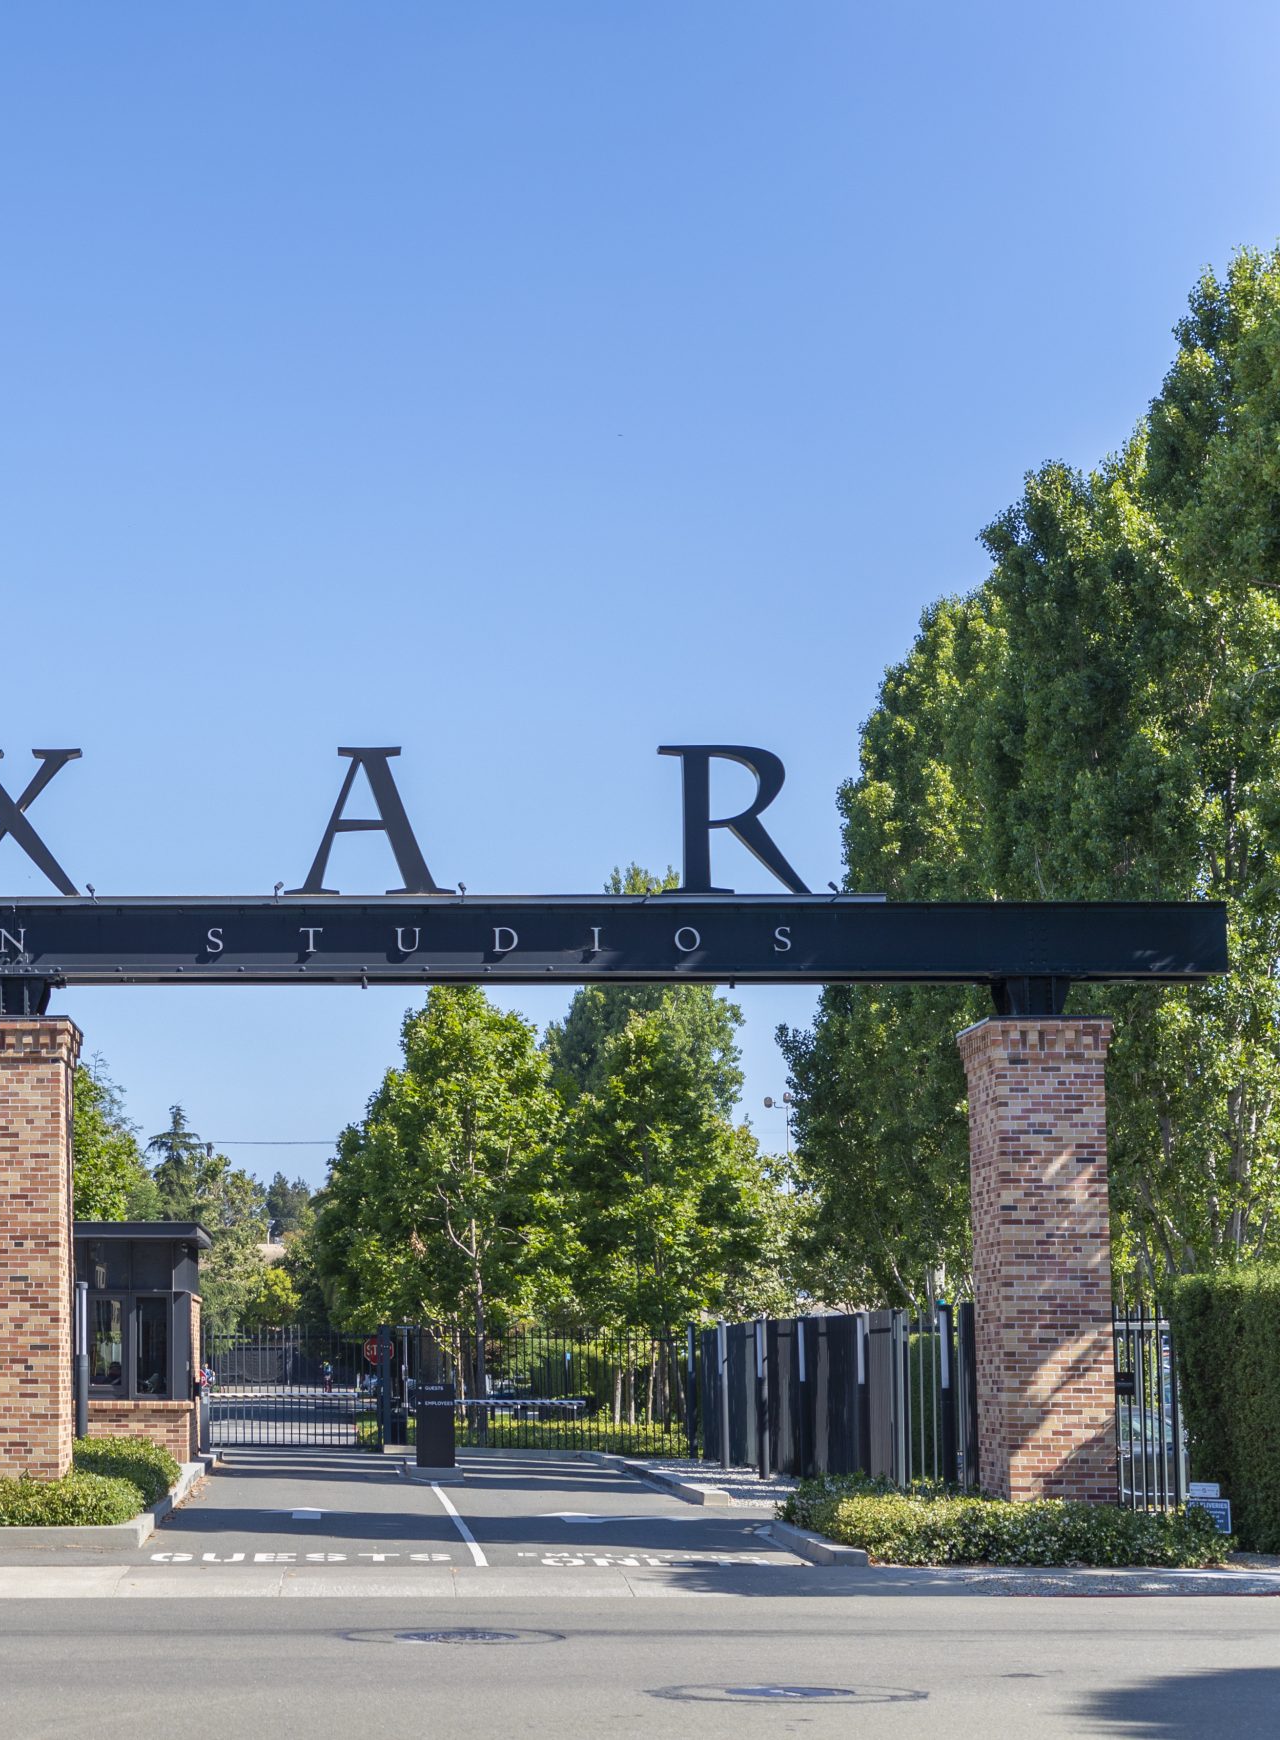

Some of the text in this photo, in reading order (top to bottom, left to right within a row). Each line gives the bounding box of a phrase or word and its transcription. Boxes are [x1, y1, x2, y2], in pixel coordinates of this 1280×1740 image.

[205, 926, 792, 954] STUDIOS
[366, 1345, 391, 1356] ST
[149, 1552, 452, 1562] GUESTS
[517, 1551, 761, 1560] EMPLOYEES
